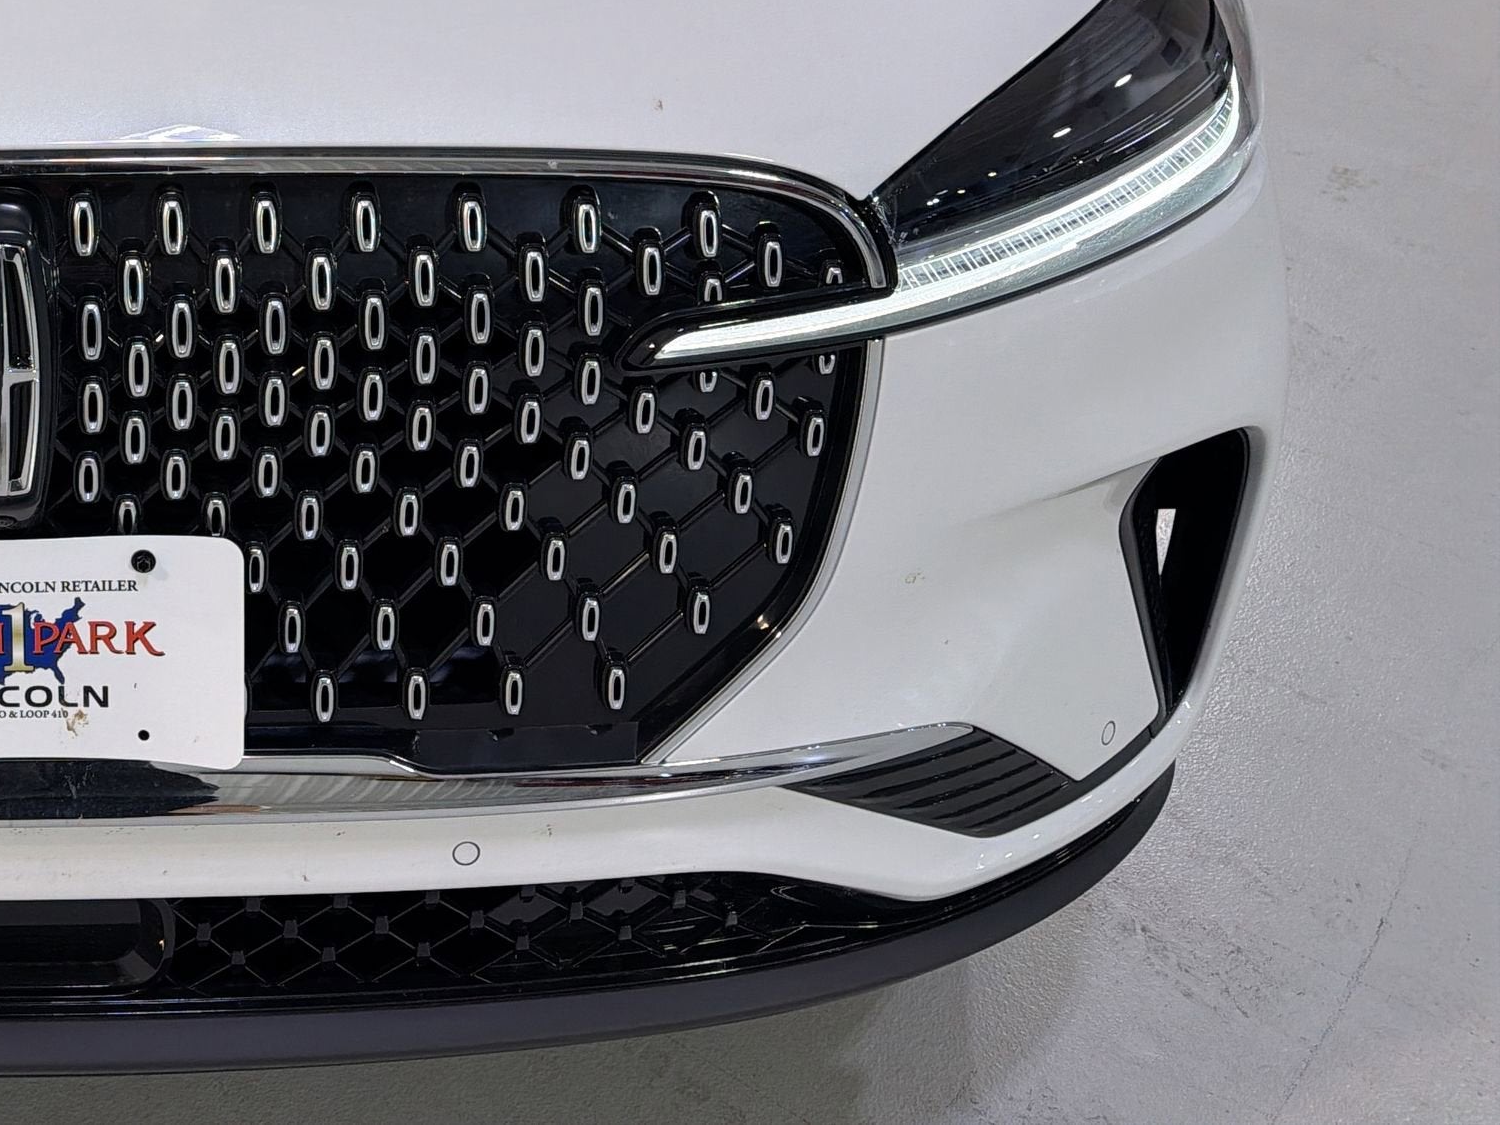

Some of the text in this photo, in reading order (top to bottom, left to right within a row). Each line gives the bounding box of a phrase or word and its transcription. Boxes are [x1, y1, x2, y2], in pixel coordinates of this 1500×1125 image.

[60, 579, 138, 593] RETAILER
[33, 620, 166, 657] PARK
[9, 710, 18, 719] &
[20, 709, 50, 719] LOOP
